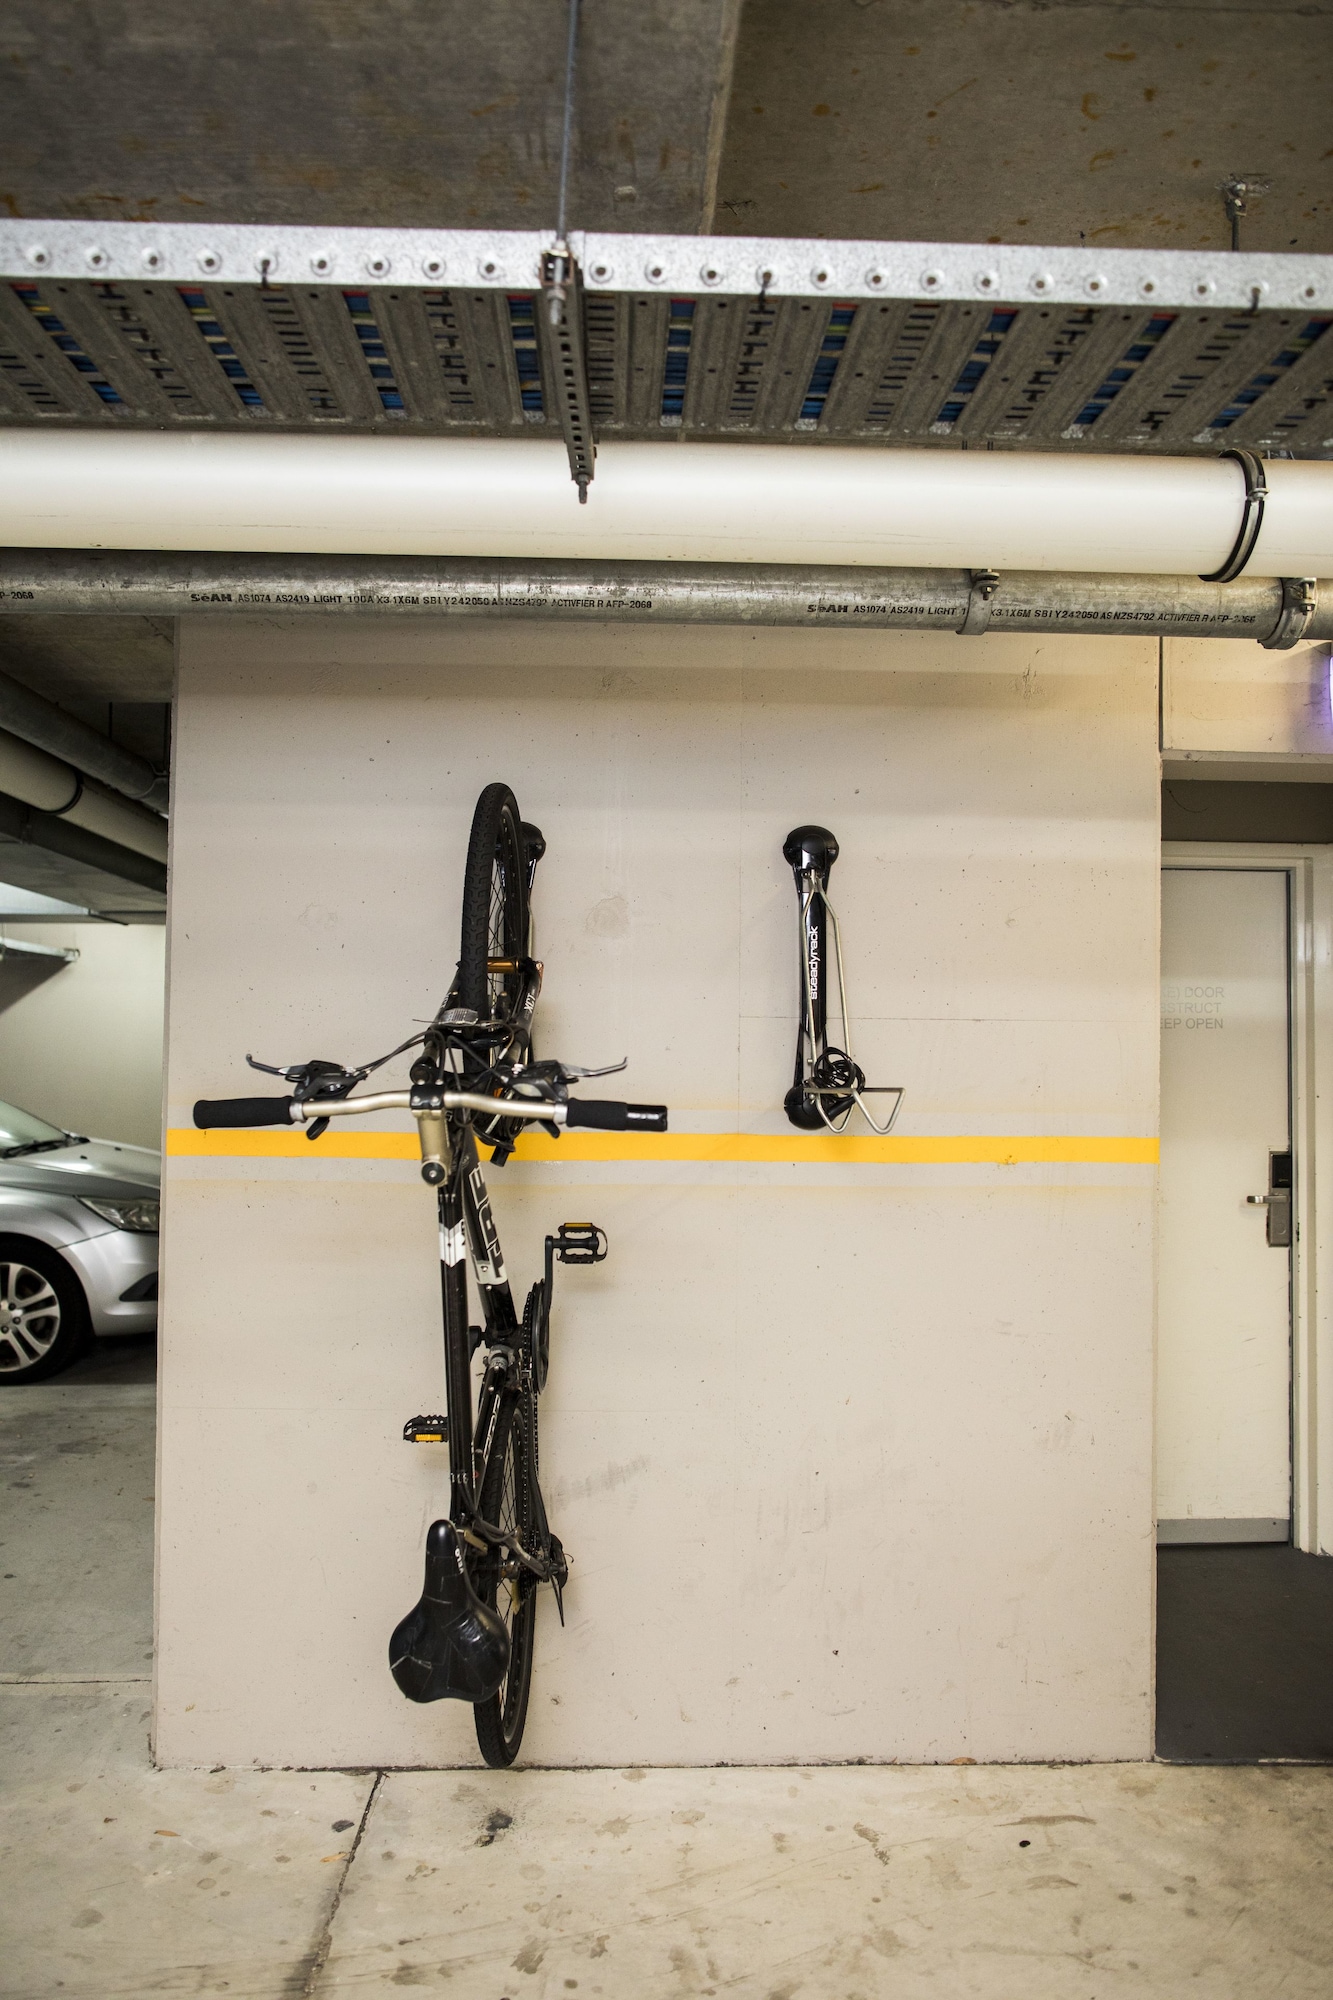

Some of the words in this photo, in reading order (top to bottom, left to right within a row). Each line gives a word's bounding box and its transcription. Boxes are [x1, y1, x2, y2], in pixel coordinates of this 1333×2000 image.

[238, 594, 271, 603] AS1074
[275, 594, 310, 603] AS2419
[313, 595, 343, 604] LIGHT
[606, 599, 652, 609] AFP-2068
[853, 605, 887, 614] AS1074
[890, 606, 924, 615] AS2419
[927, 607, 957, 616] LIGHT
[808, 925, 821, 1000] steadyrack
[1184, 986, 1225, 998] DOOR
[523, 992, 536, 1014] XCT
[1185, 1017, 1224, 1030] OPEN
